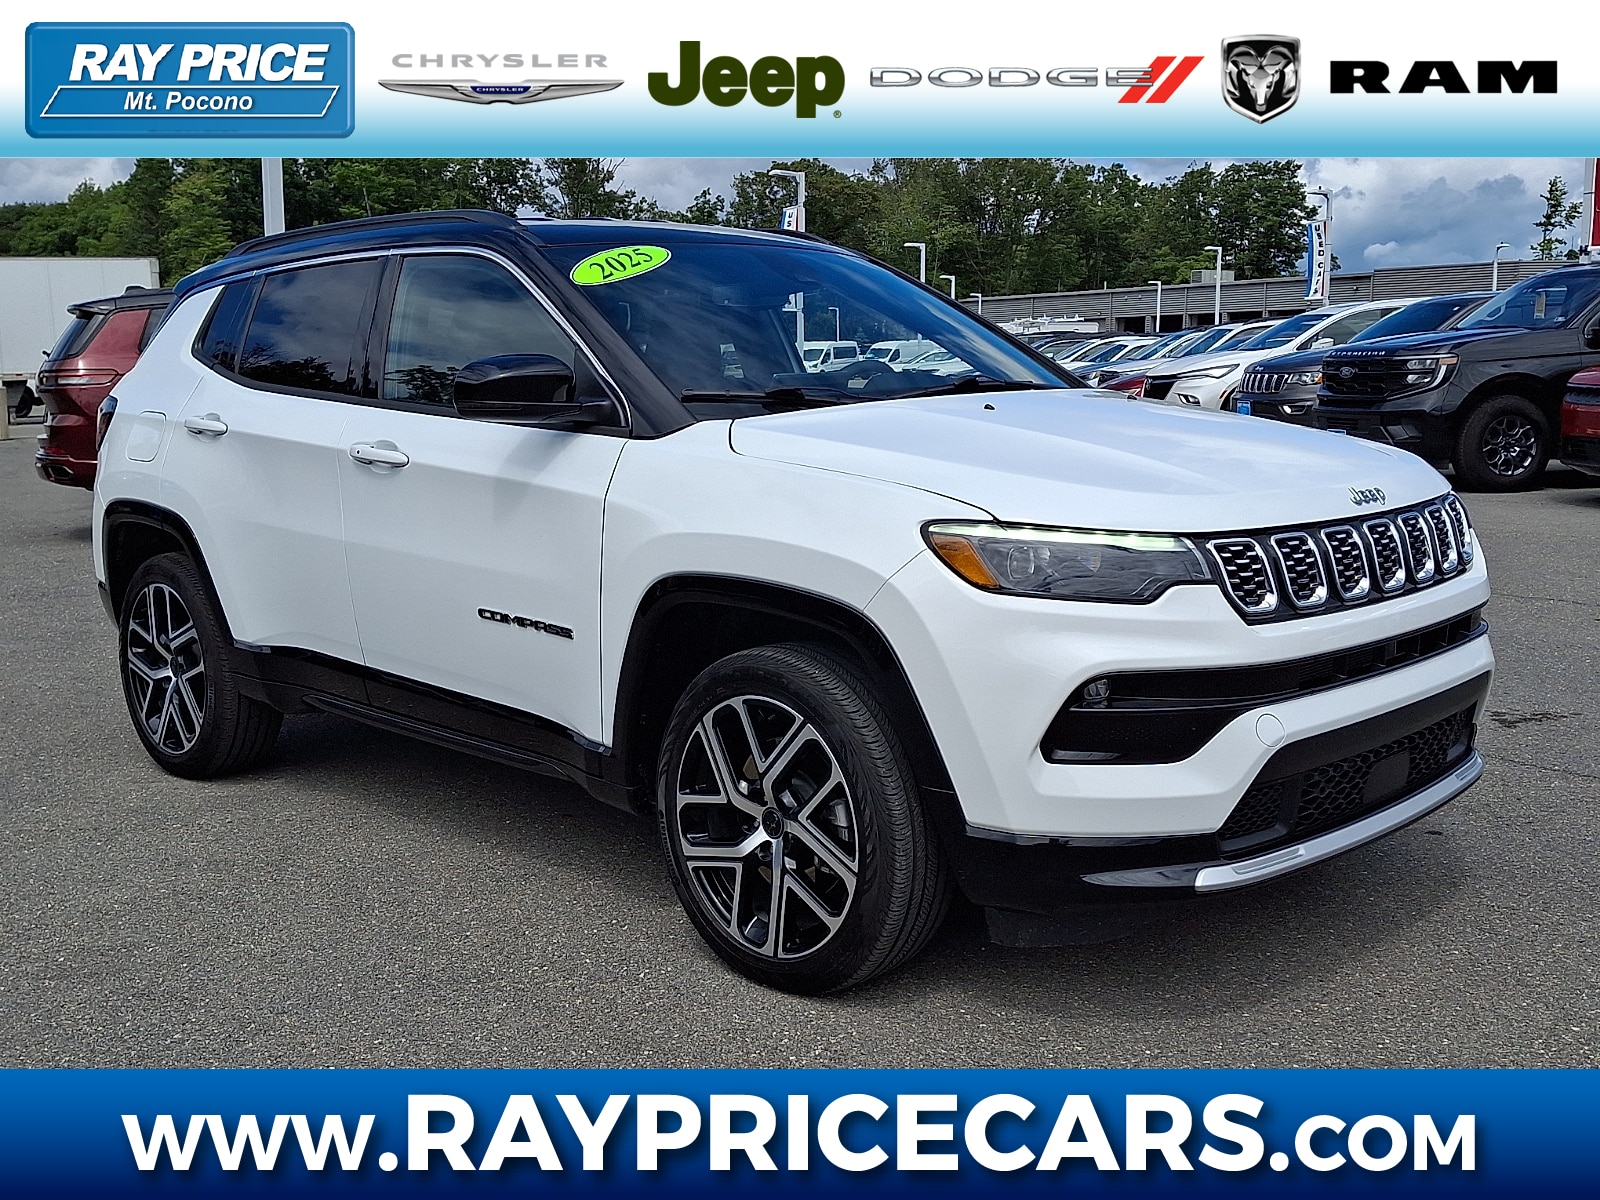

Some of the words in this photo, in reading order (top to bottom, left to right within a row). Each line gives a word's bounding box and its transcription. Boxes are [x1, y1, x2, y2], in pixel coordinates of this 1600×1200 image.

[1314, 224, 1325, 257] USED
[589, 248, 653, 281] 2025
[1347, 486, 1387, 507] Jeep
[477, 607, 575, 641] COMPASS
